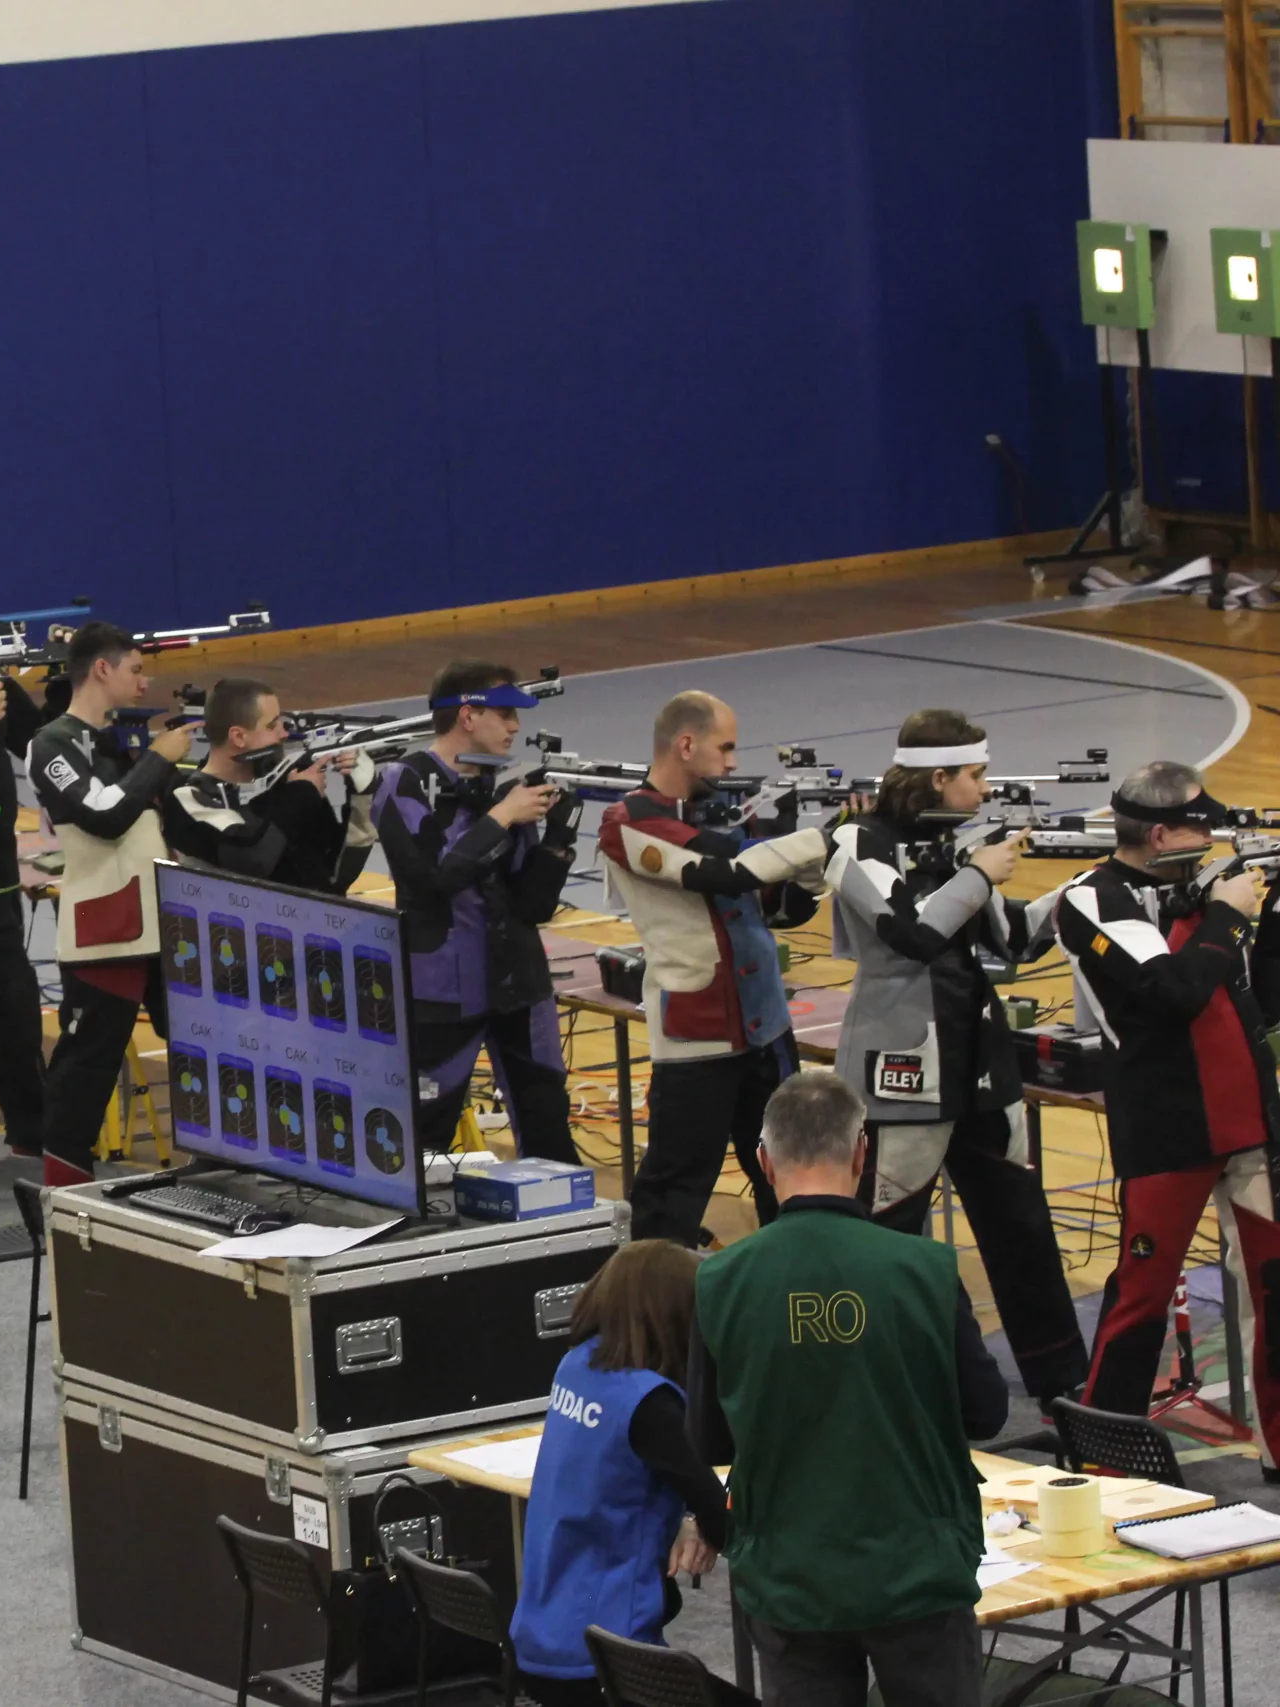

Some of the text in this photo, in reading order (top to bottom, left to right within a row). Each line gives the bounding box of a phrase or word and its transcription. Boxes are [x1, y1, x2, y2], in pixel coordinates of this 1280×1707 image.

[181, 882, 202, 898] LOK
[229, 893, 250, 909] SLO
[276, 904, 299, 920] LOK
[324, 913, 348, 931] TEK
[238, 1034, 259, 1051] SLO
[285, 1047, 308, 1062] CAK
[334, 1057, 358, 1076] TEK
[883, 1071, 921, 1089] ELEY
[789, 1290, 866, 1344] RO
[303, 1528, 321, 1544] 1-10
